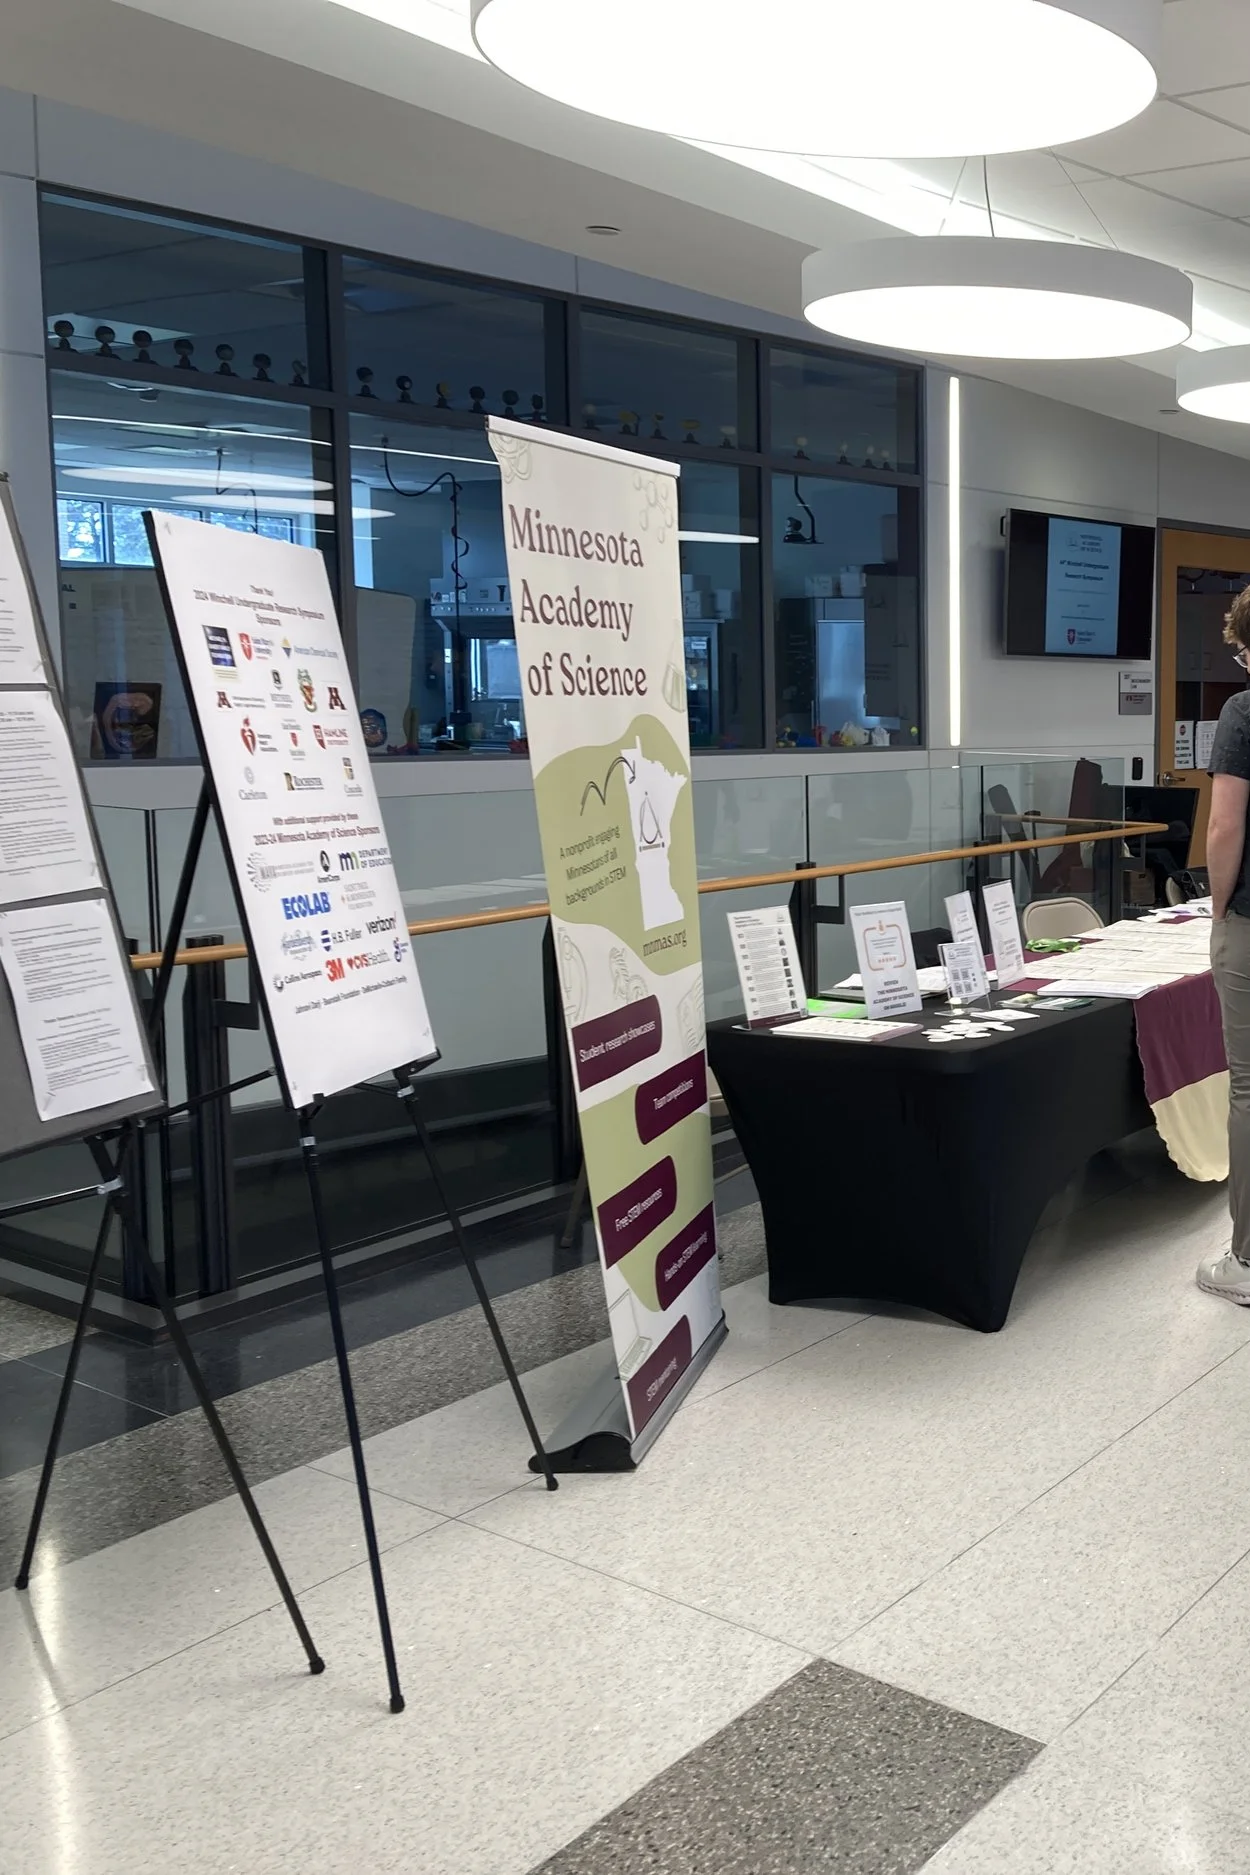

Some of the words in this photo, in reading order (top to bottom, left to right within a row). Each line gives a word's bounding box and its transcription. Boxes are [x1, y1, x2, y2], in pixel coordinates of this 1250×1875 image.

[508, 504, 644, 568] Minnesota
[520, 578, 634, 642] Academy
[527, 652, 553, 697] of
[560, 652, 648, 697] Science
[306, 829, 331, 842] Academy
[336, 827, 357, 838] Science
[280, 890, 332, 920] ECOLAB
[345, 928, 363, 942] Fuller
[365, 915, 397, 935] verizon
[642, 930, 688, 957] mnmas.org
[325, 957, 346, 982] 3M
[579, 1041, 606, 1063] Student
[615, 1215, 630, 1232] Free
